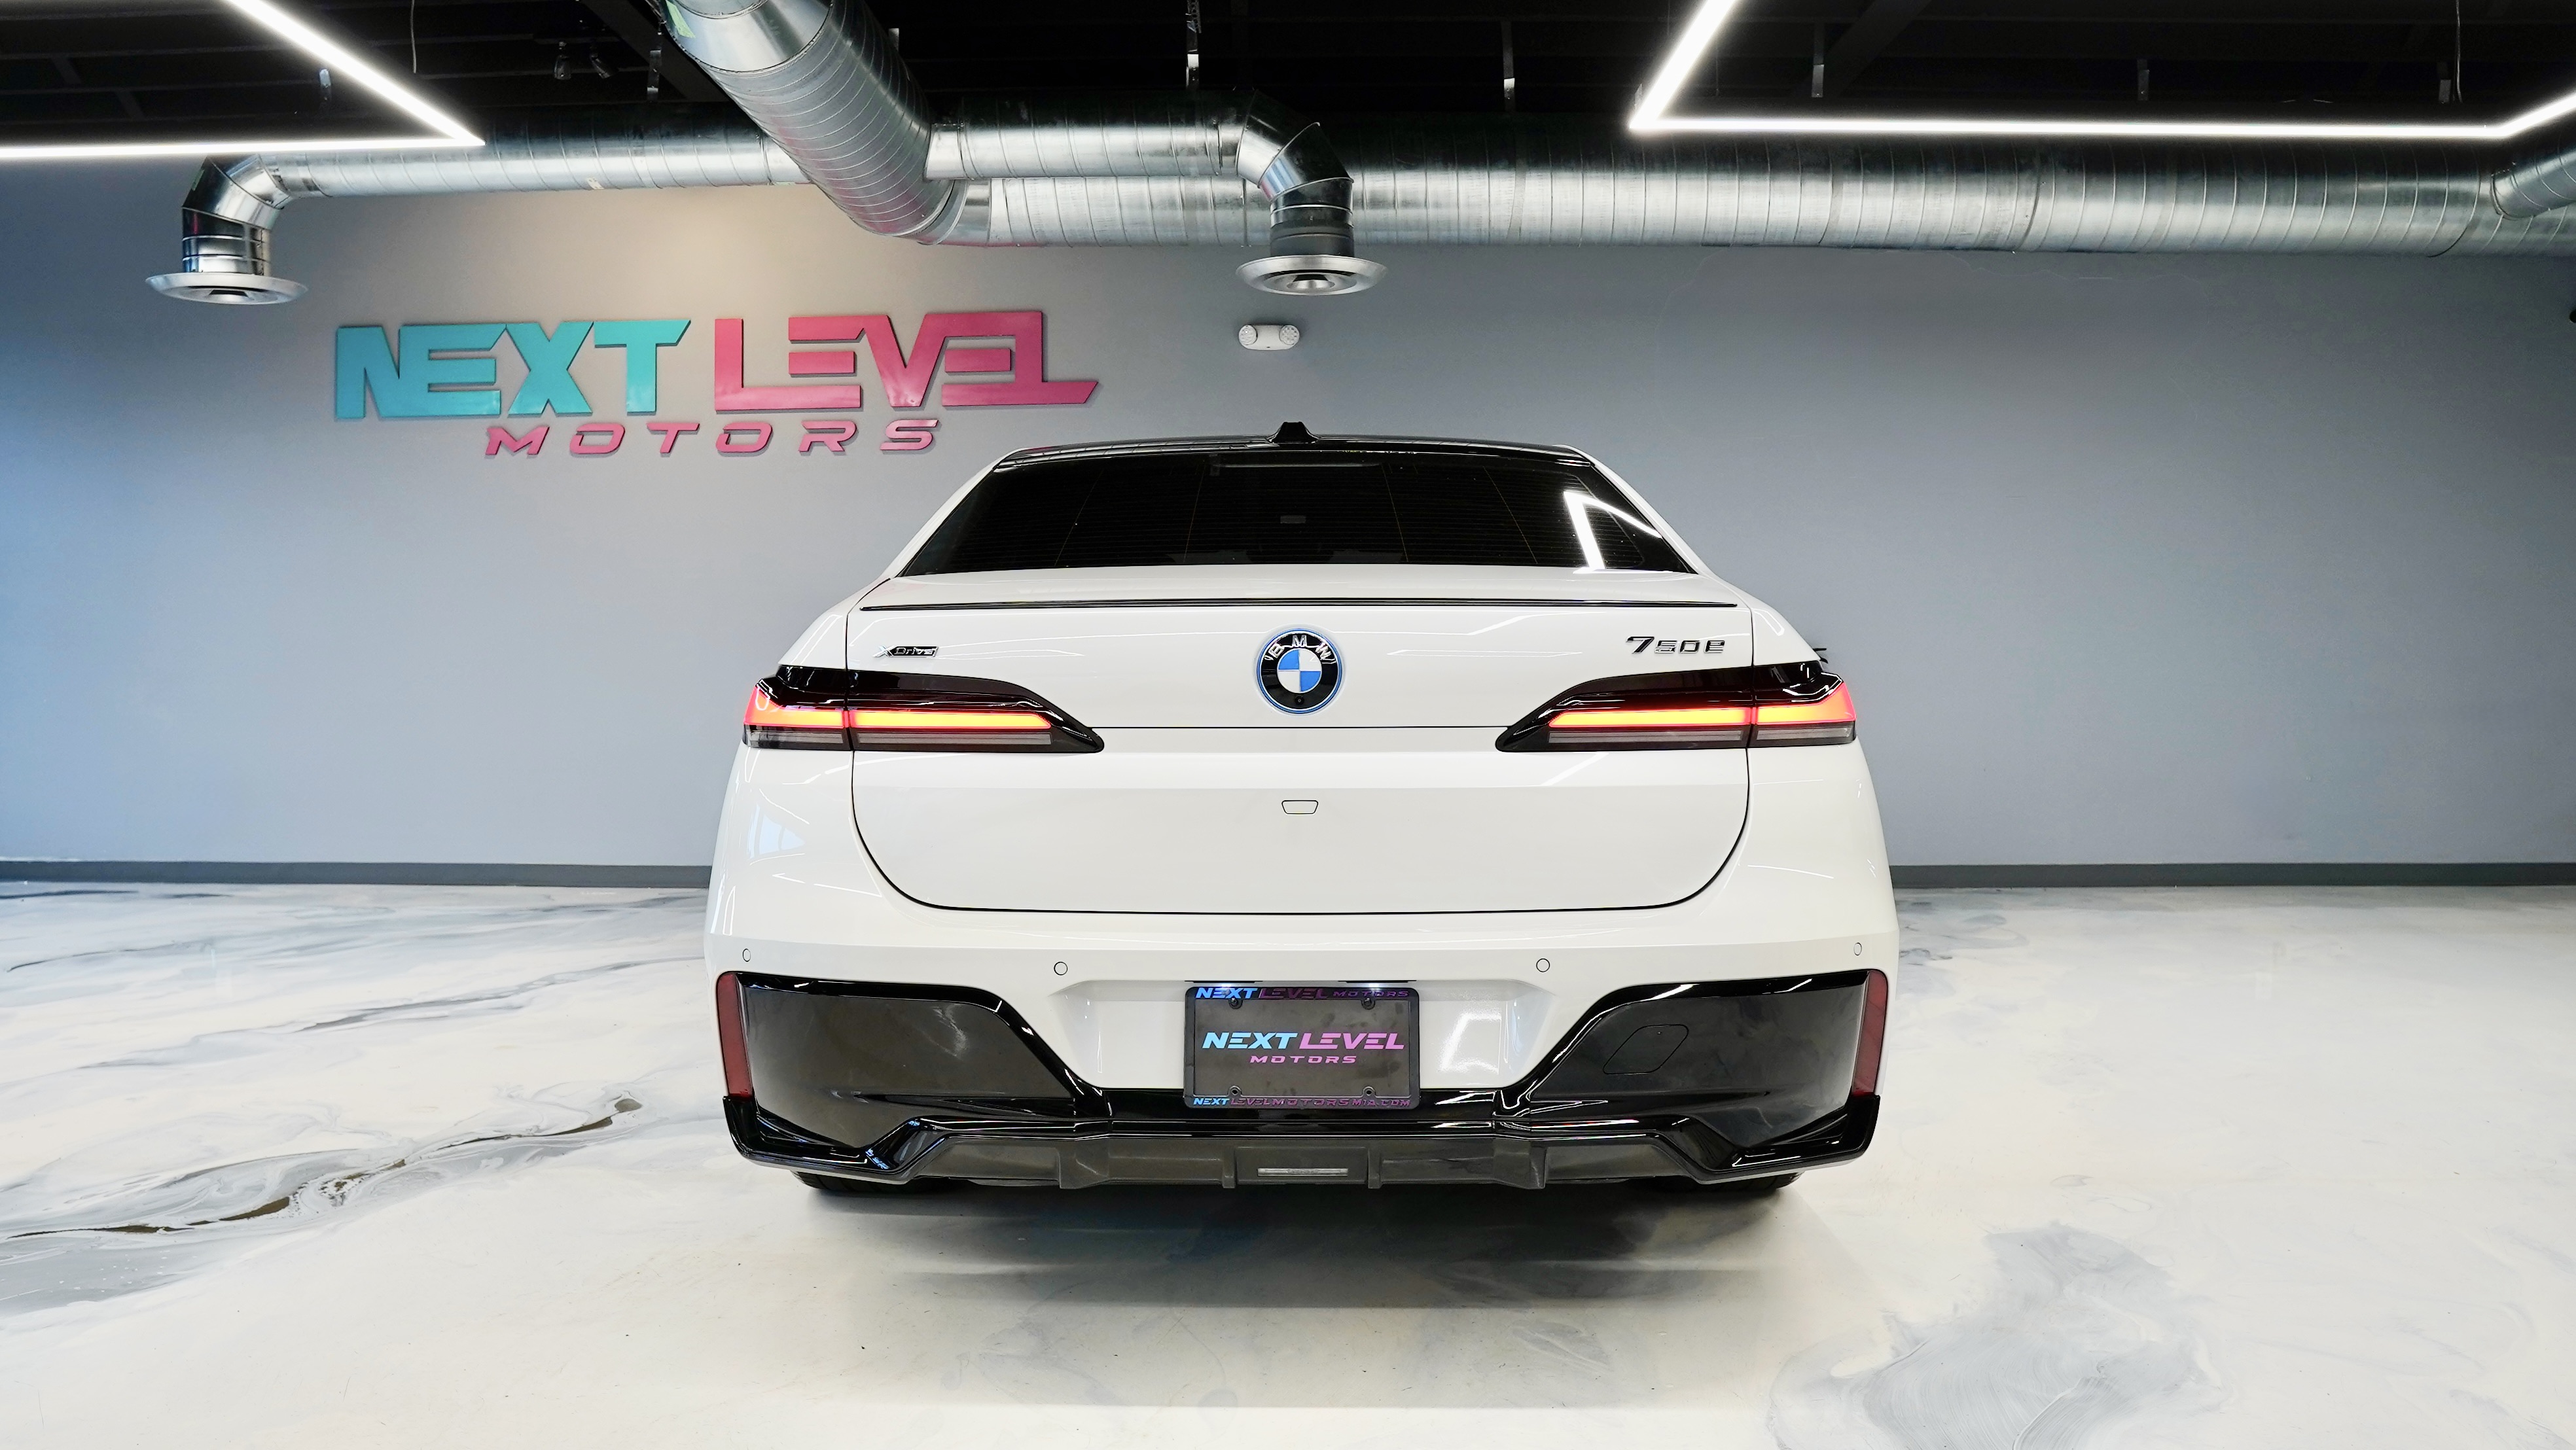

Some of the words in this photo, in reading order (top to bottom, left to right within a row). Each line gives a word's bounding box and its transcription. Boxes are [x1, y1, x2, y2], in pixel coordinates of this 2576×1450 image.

[334, 320, 691, 418] NEXT
[714, 311, 1100, 411] LEVEL
[484, 419, 940, 456] MOTORS
[1267, 635, 1333, 660] BMW
[1195, 987, 1258, 999] NEXT
[1259, 988, 1328, 1000] LEVEL
[1202, 1032, 1298, 1050] NEXT
[1299, 1033, 1405, 1050] LEVEL
[1249, 1055, 1357, 1064] MOTORS
